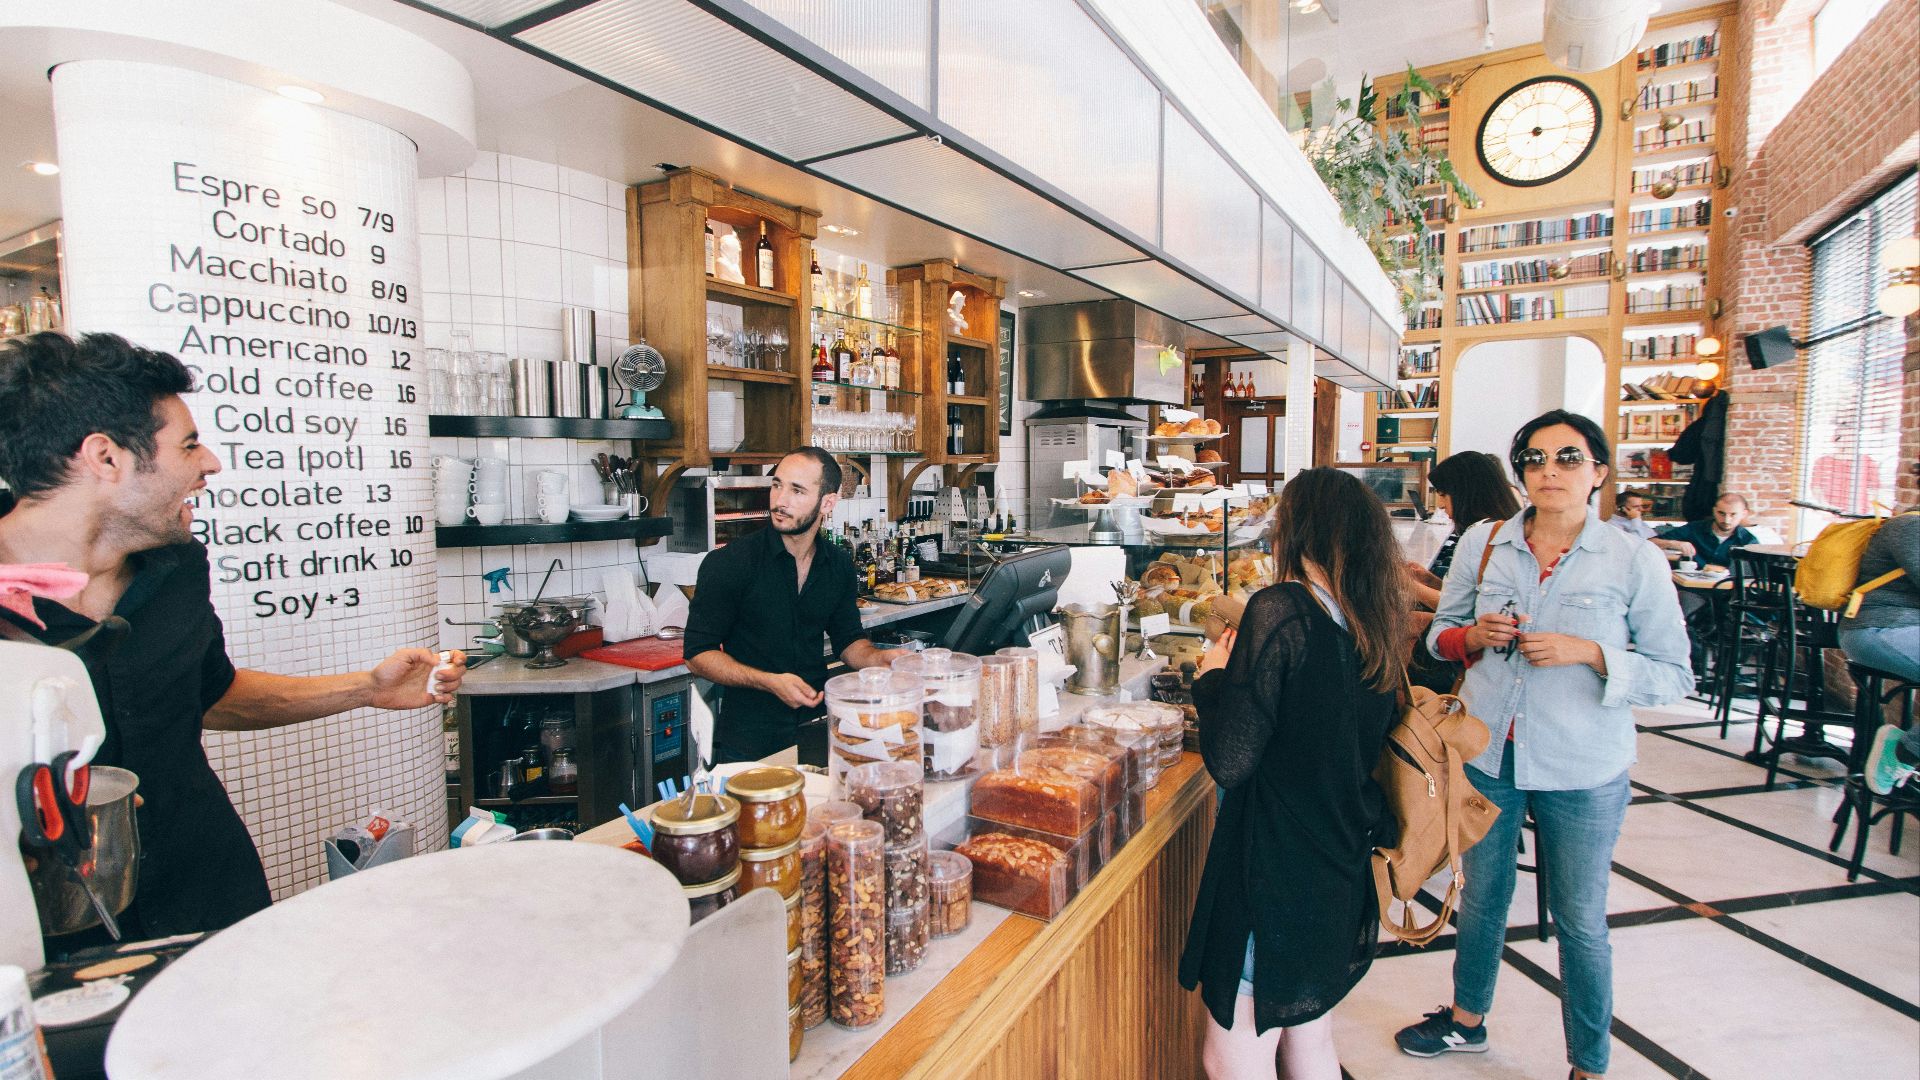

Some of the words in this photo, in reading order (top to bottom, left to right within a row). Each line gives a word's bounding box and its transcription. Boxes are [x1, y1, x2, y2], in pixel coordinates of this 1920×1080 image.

[212, 210, 346, 258] Cortado
[370, 244, 386, 265] 9
[356, 206, 396, 234] 7/9
[170, 243, 348, 294] Macchiato
[371, 279, 408, 304] 8/9
[148, 282, 351, 330] Cappuccino
[367, 312, 418, 339] 10/13
[179, 325, 368, 367] Americano
[391, 349, 412, 371] 12
[185, 364, 261, 395] Cold
[275, 371, 374, 401] coffee
[397, 383, 417, 404] 16
[214, 404, 295, 433] Cold
[305, 413, 359, 442] soy
[384, 416, 408, 437] 16
[220, 442, 285, 470] Tea
[390, 449, 413, 469] 16
[194, 480, 343, 508] hocolate
[366, 483, 392, 503] 13
[191, 516, 284, 546] Black
[296, 512, 391, 541] coffee
[405, 514, 424, 535] 10
[217, 552, 291, 584] Soft
[300, 546, 378, 577] drink
[390, 548, 413, 568] 10
